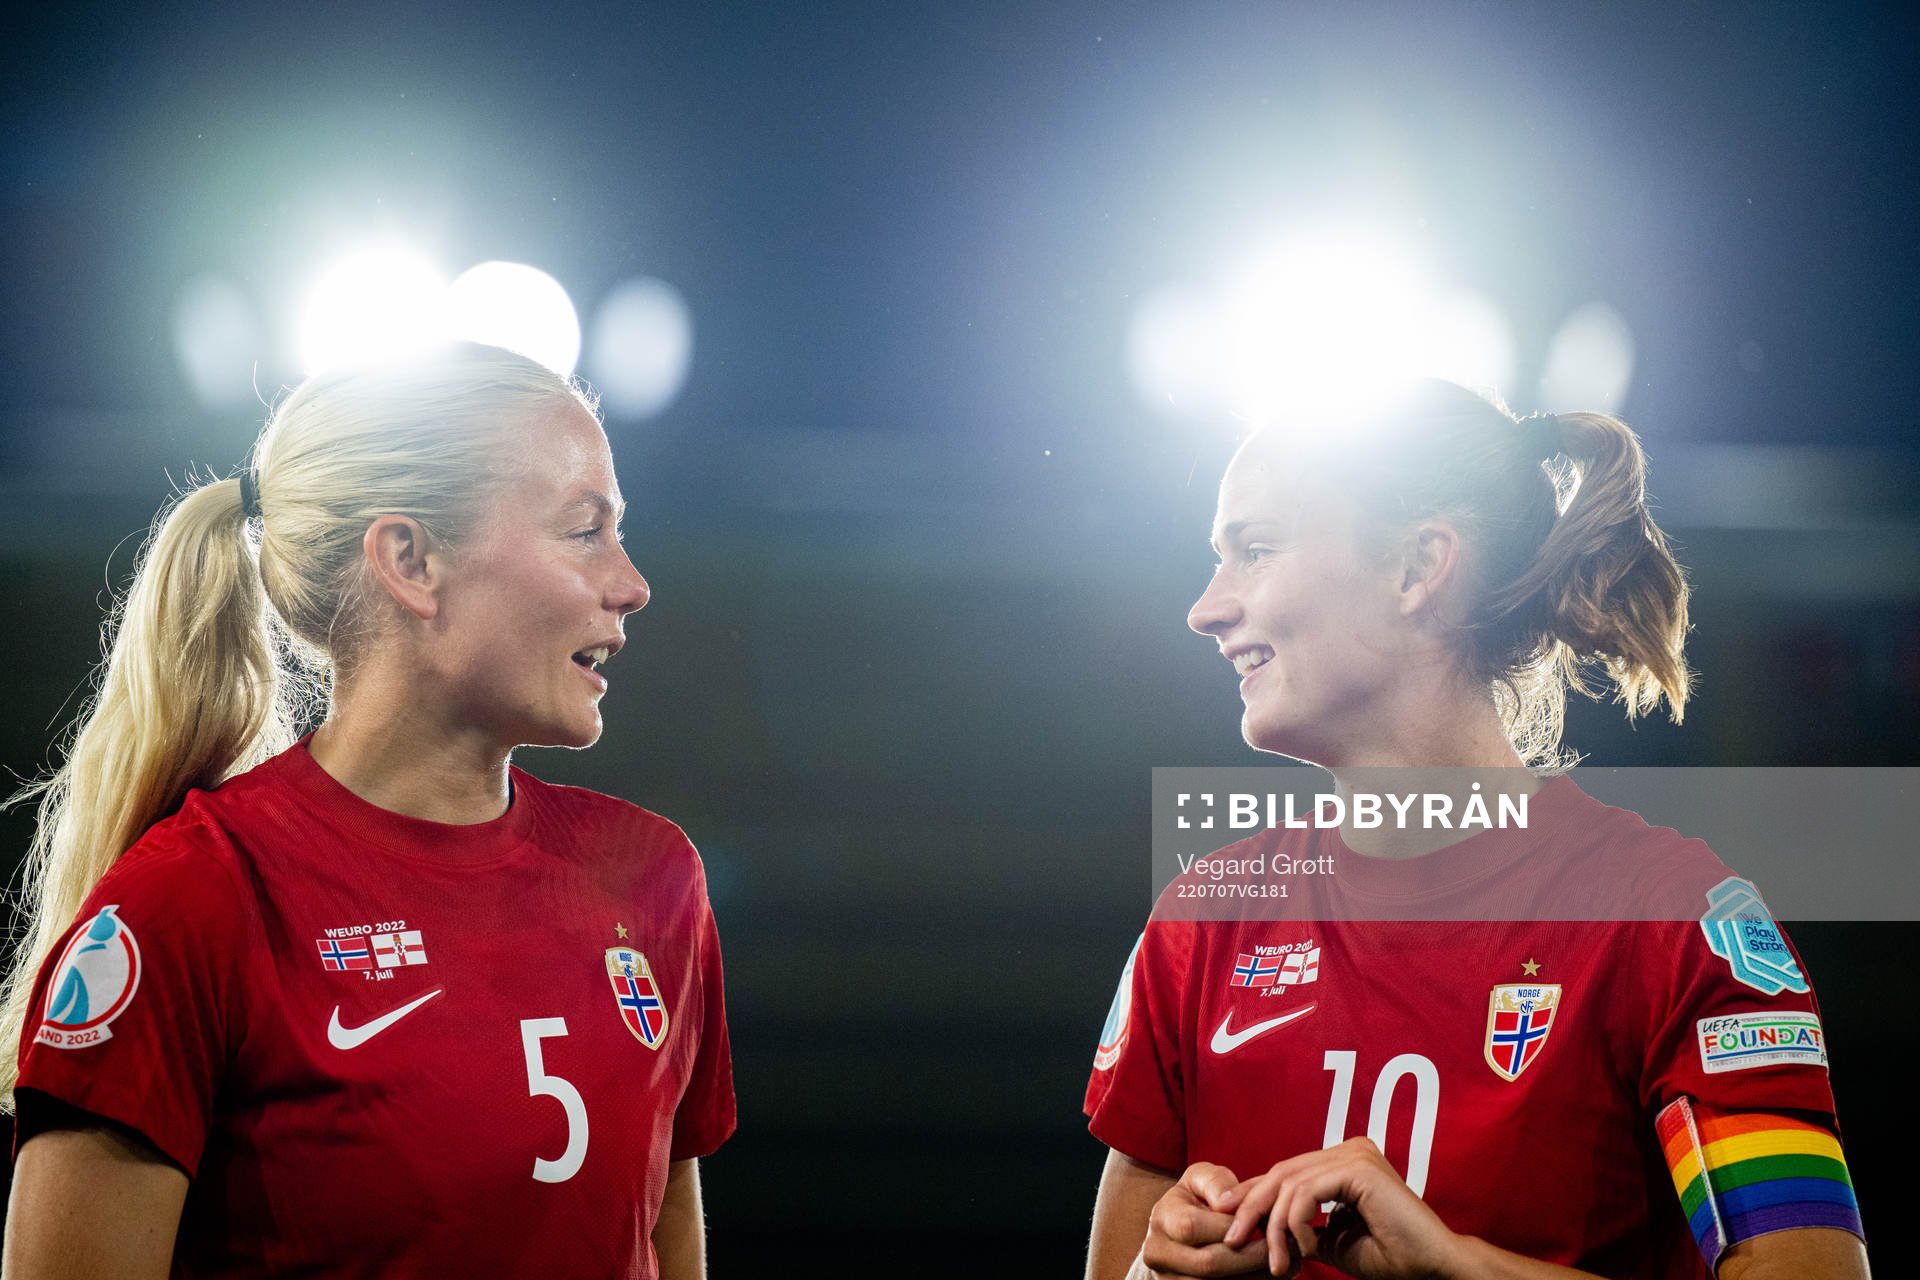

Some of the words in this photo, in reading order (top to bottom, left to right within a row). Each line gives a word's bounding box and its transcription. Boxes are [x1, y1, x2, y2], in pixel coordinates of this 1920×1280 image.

[1737, 912, 1762, 924] We
[324, 924, 373, 938] WEURO
[375, 920, 407, 933] 2022
[1745, 926, 1777, 942] Play
[1255, 944, 1292, 955] WEURO
[363, 971, 374, 981] 7.
[375, 969, 394, 981] juli
[1268, 985, 1287, 997] juli
[1517, 988, 1541, 998] NORGE
[1702, 1018, 1740, 1033] UEFA
[67, 1030, 100, 1045] 2022
[520, 1017, 589, 1184] 5
[1321, 1050, 1440, 1213] 10
